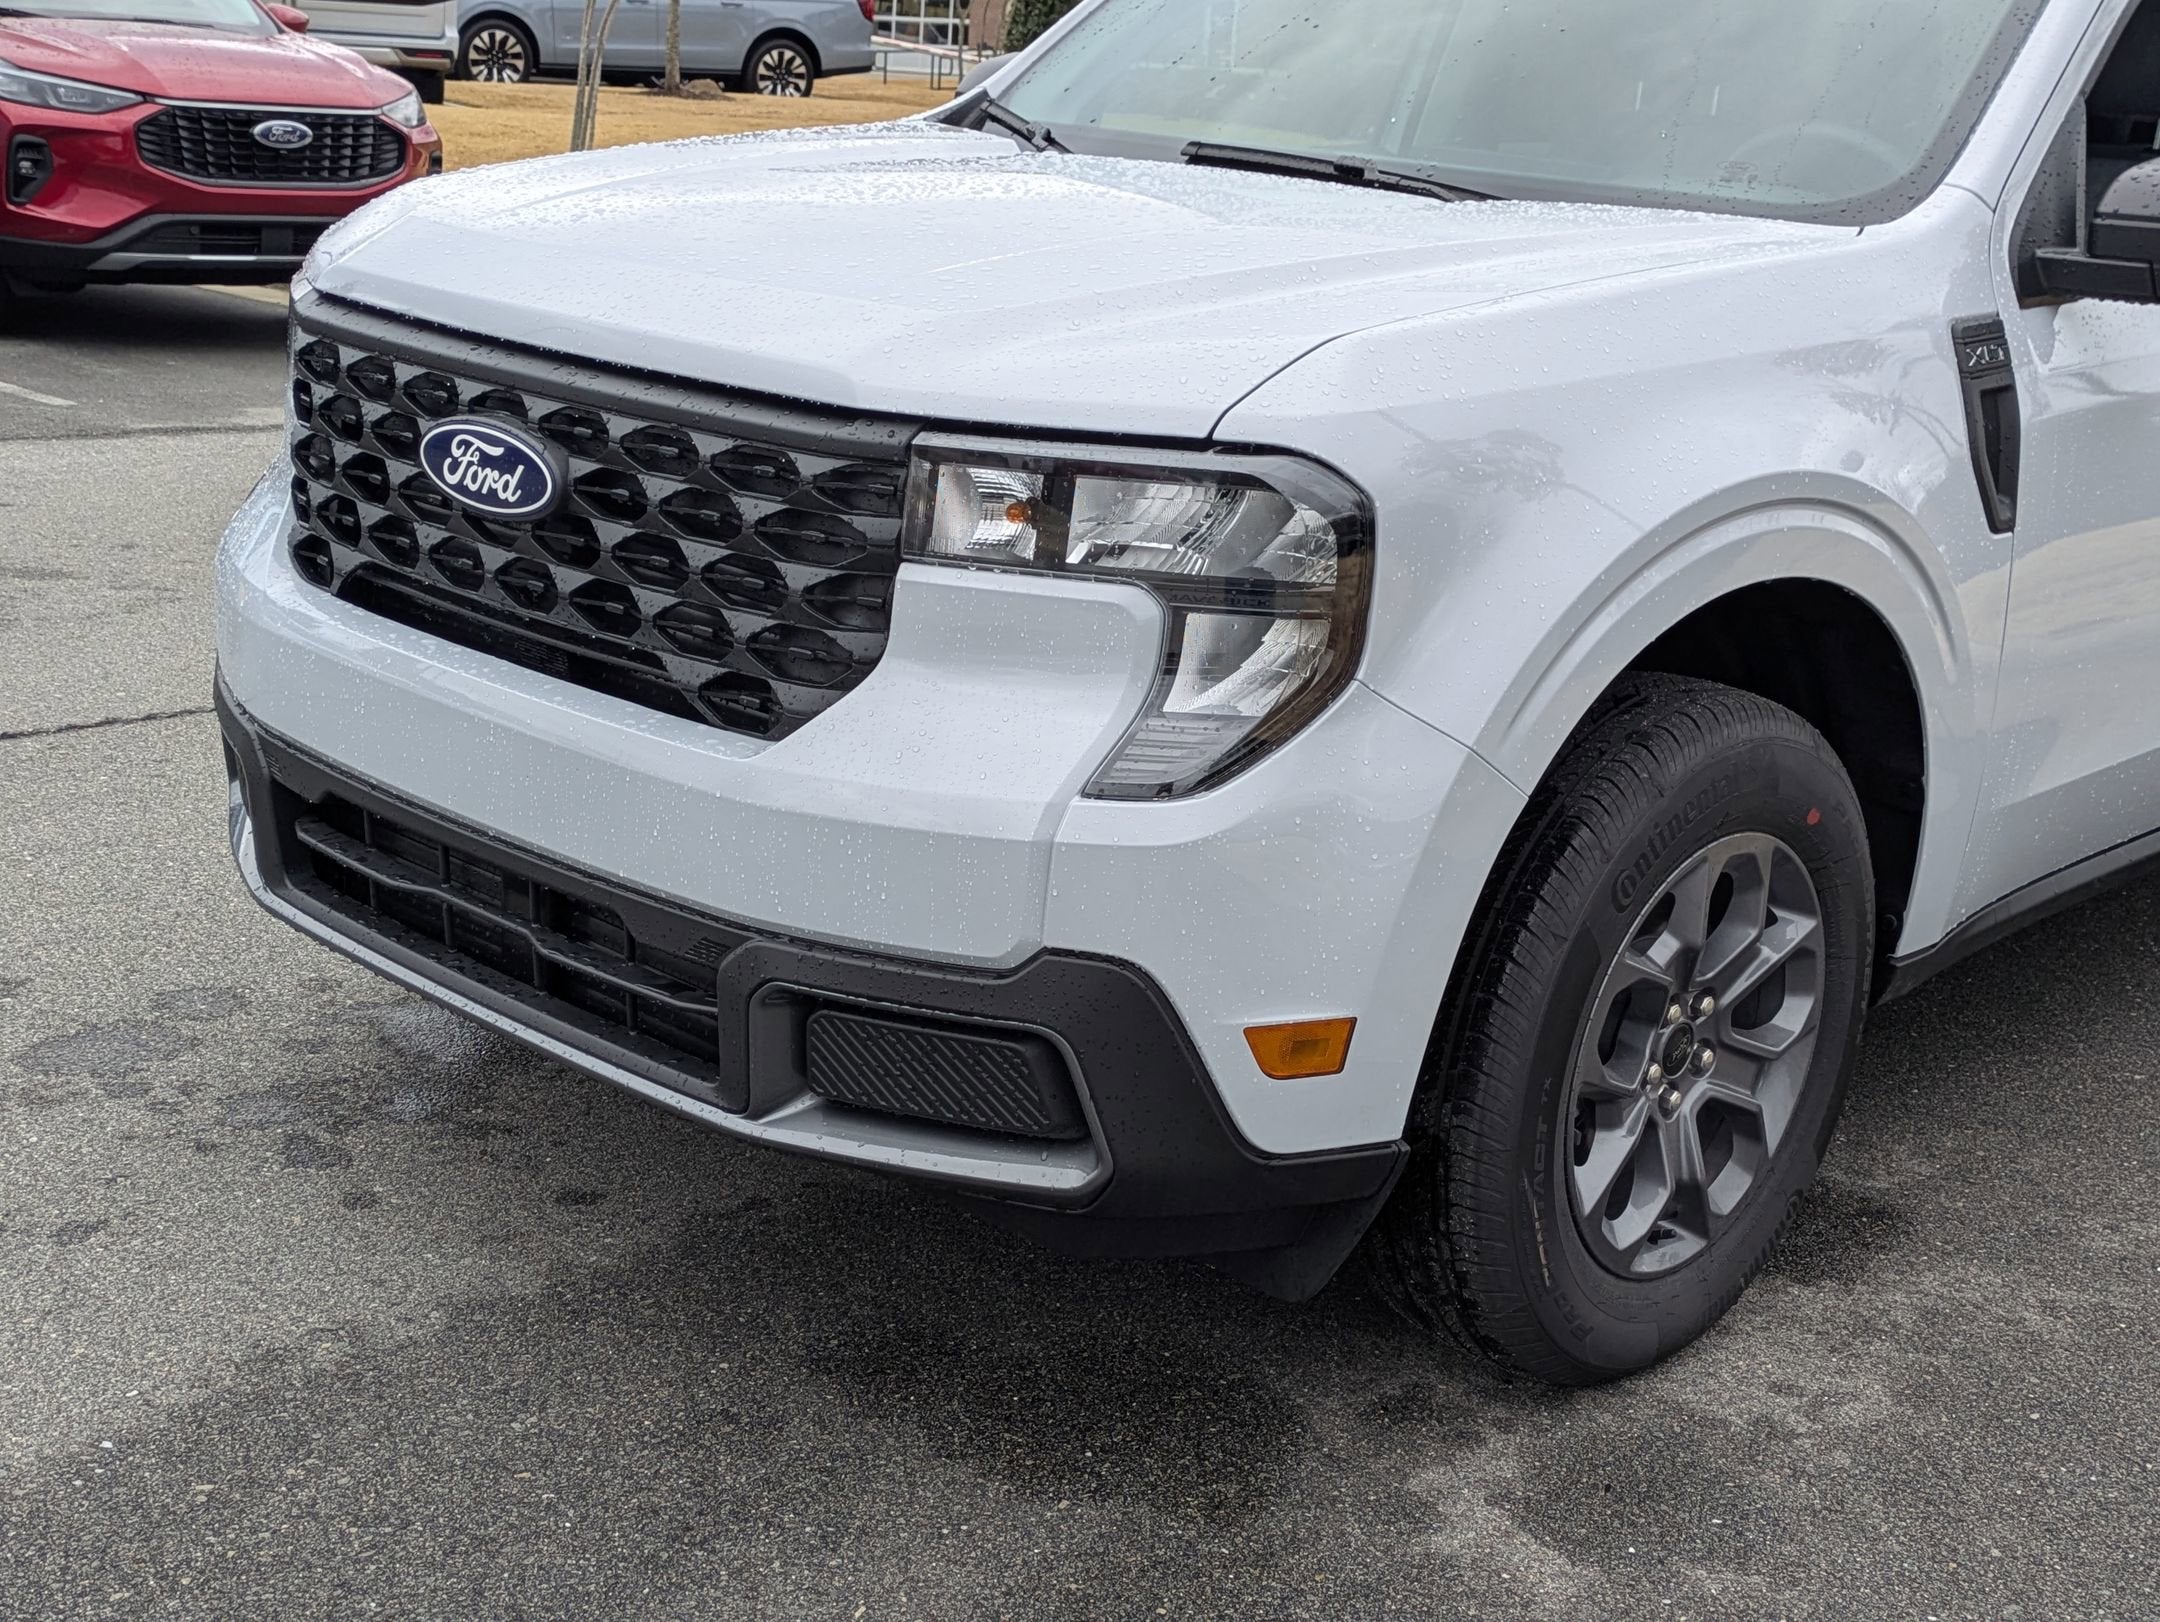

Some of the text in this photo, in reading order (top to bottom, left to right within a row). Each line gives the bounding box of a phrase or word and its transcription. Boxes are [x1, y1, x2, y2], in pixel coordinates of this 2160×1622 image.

[269, 126, 300, 142] Ford
[1966, 345, 2008, 366] XLT
[443, 434, 525, 503] Ford
